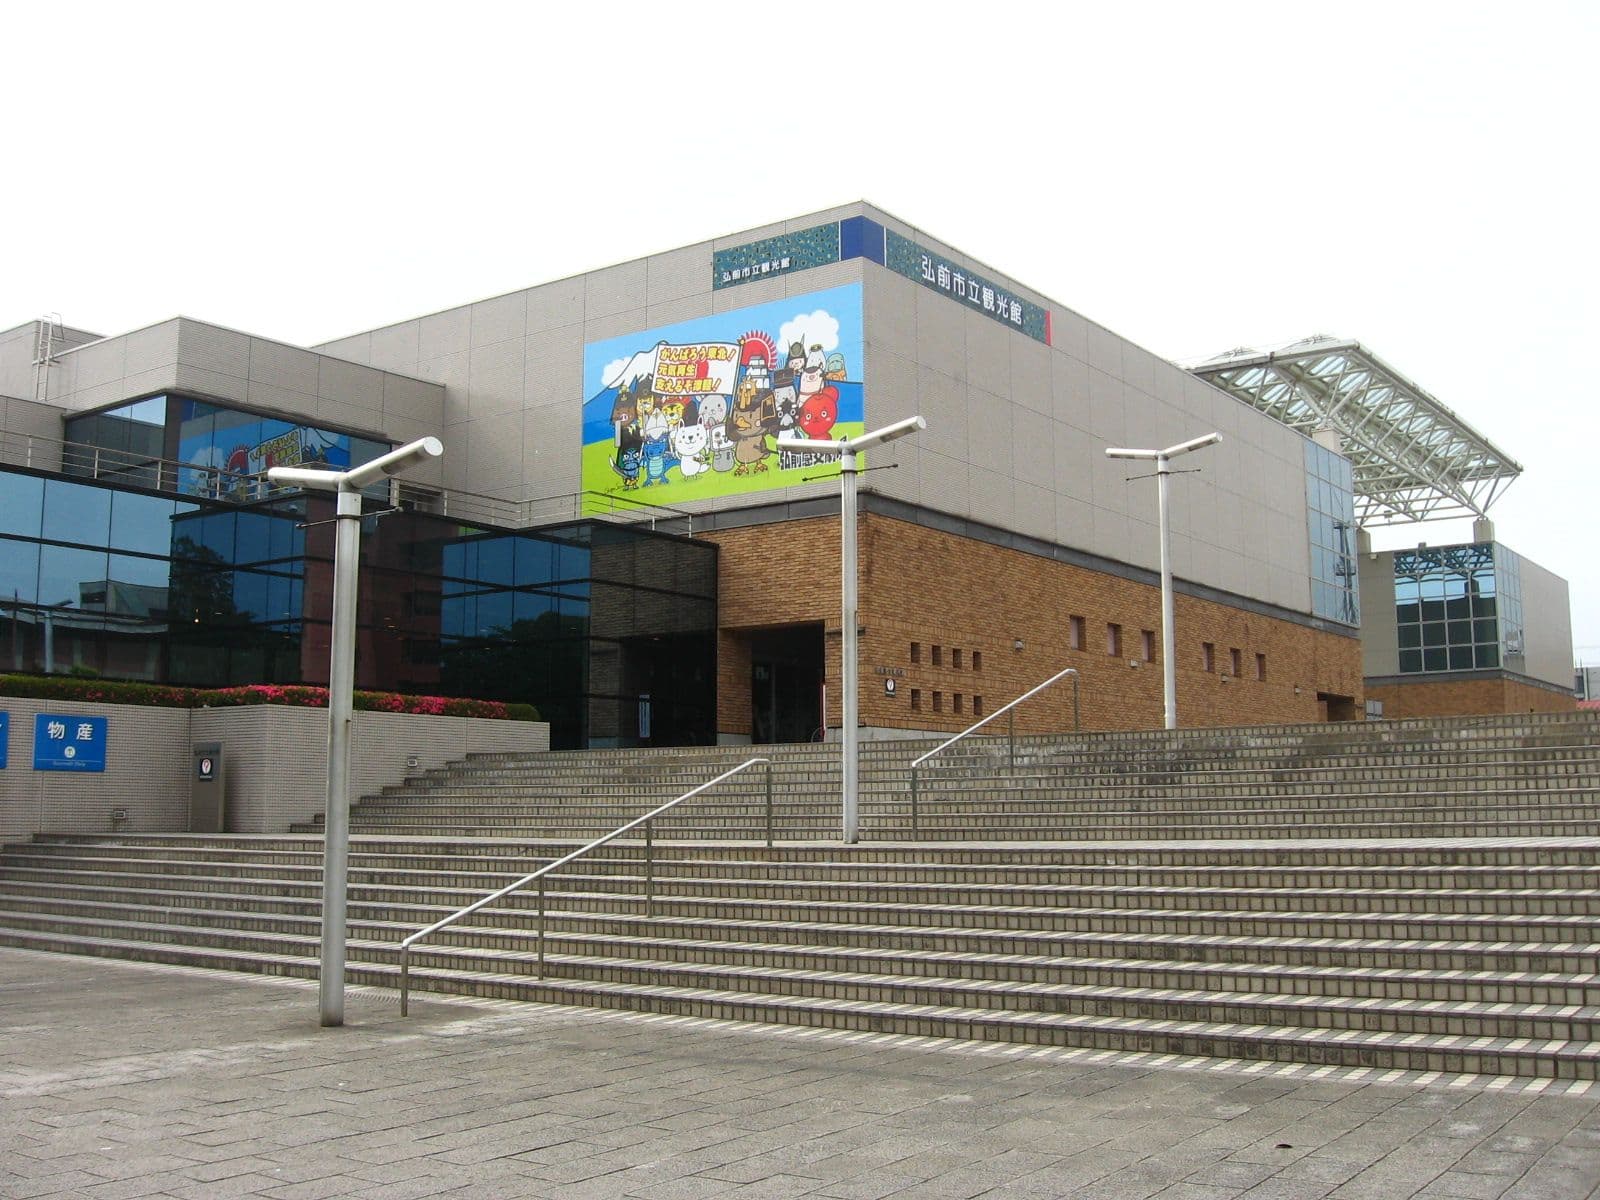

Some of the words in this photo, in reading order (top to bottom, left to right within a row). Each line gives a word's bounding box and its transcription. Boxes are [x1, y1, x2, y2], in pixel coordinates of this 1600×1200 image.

[921, 254, 1022, 325] 弘前市立観光館
